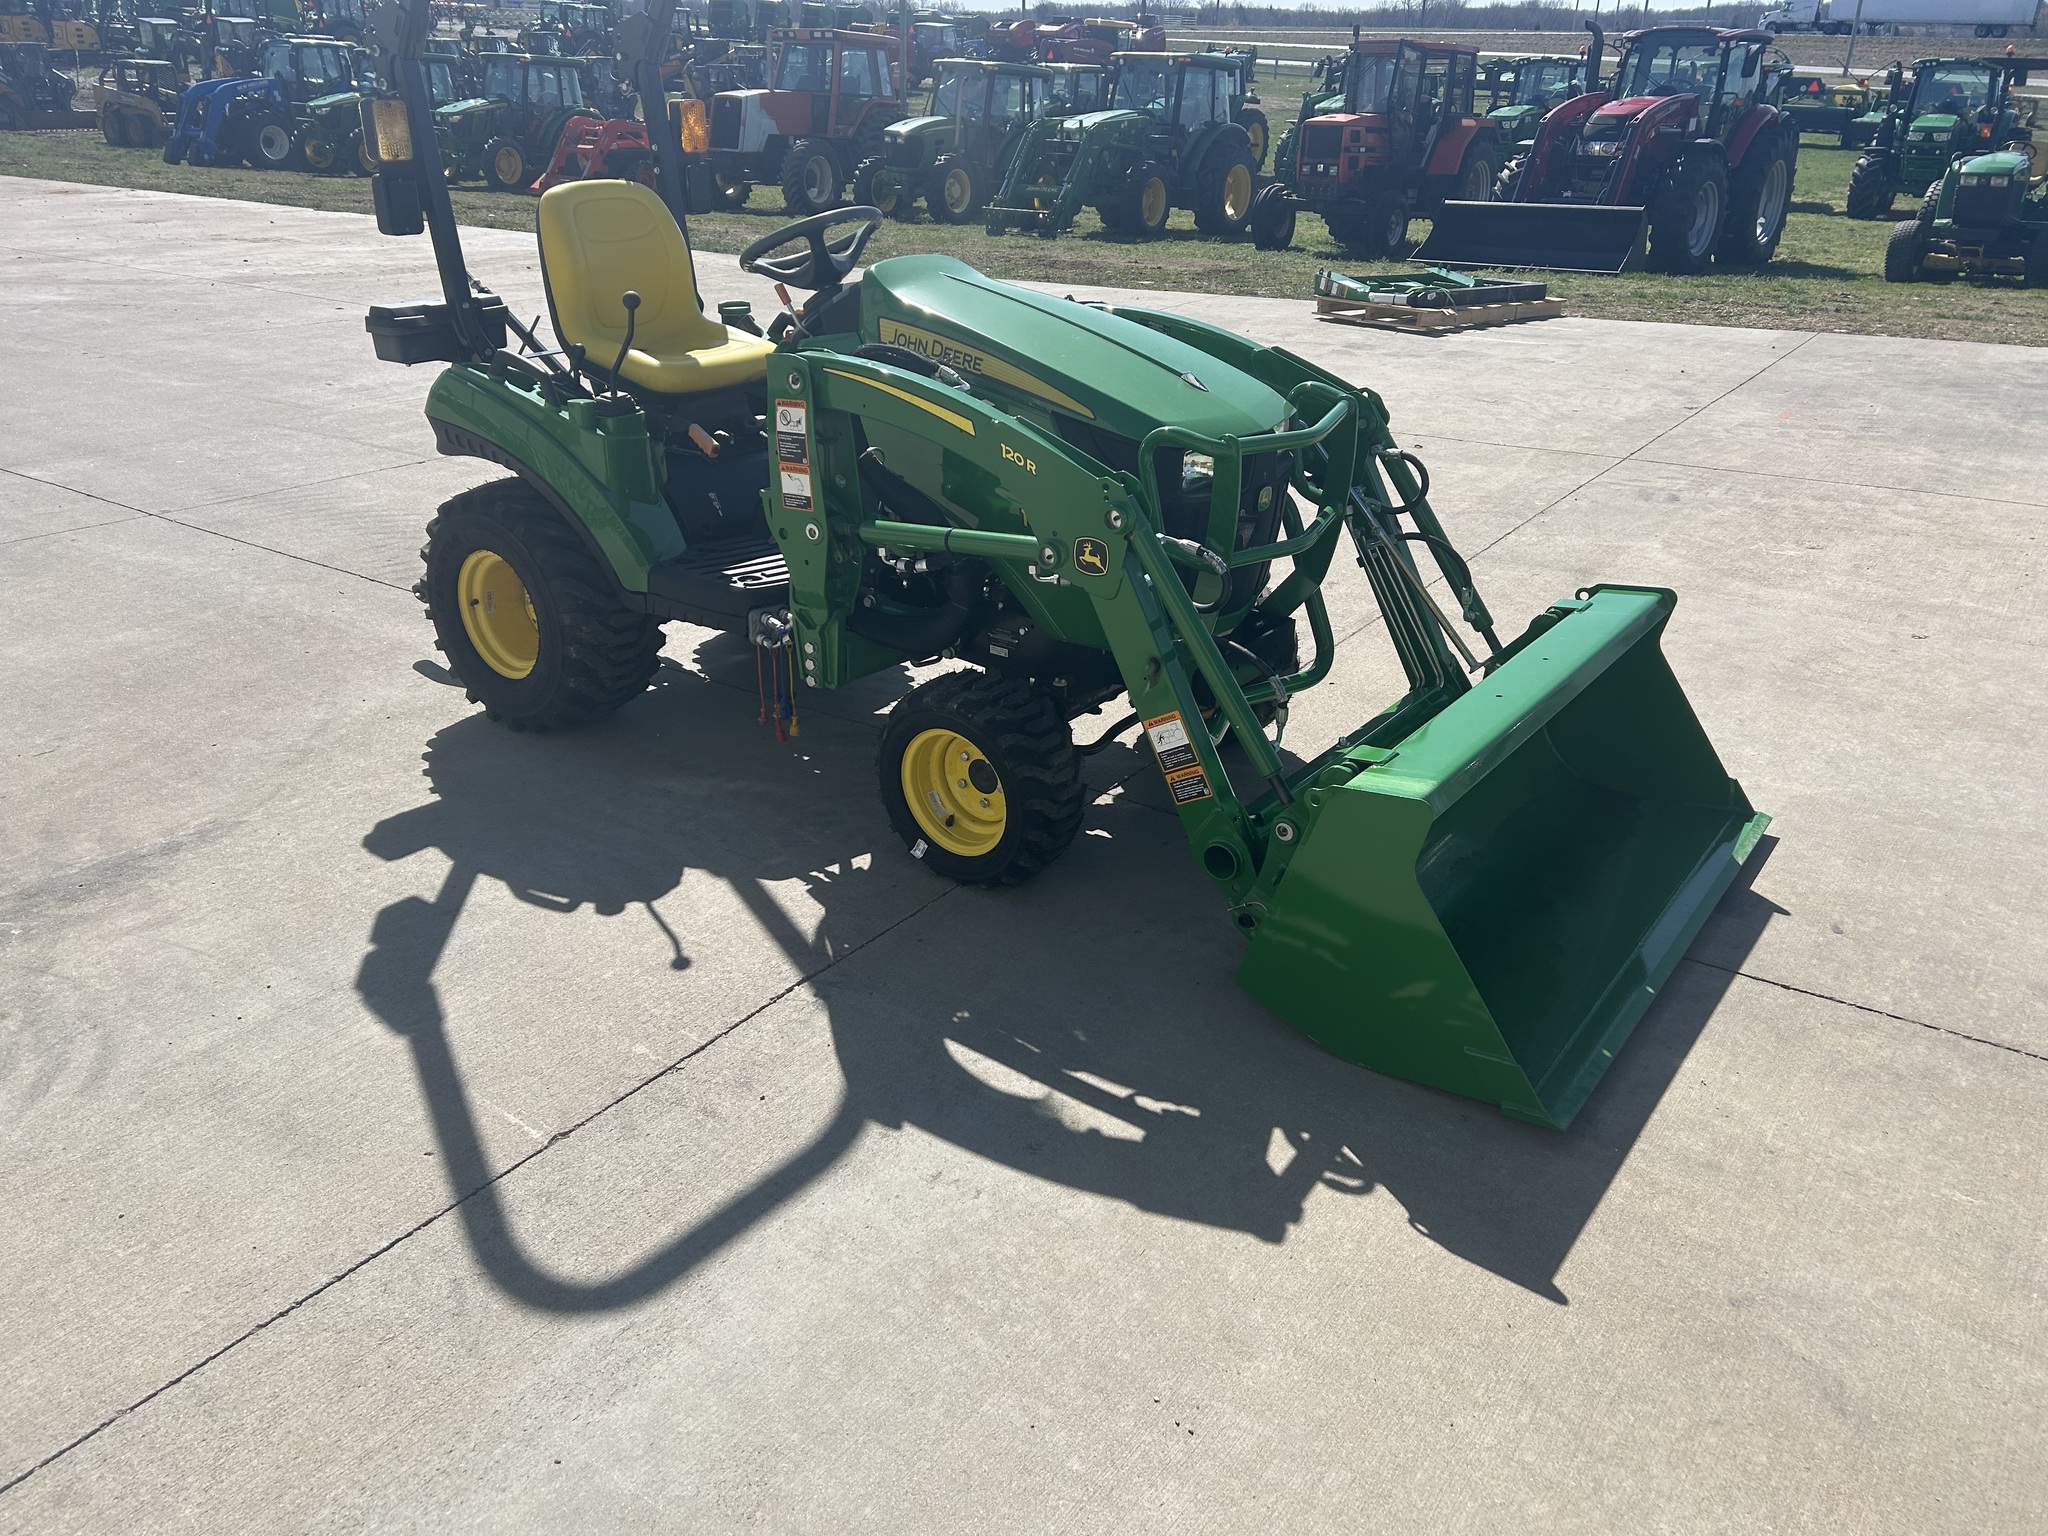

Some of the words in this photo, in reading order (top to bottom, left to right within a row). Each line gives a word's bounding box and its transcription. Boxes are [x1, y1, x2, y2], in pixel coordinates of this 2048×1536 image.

[888, 328, 929, 356] JOHN
[931, 339, 983, 372] DEERE
[781, 400, 805, 408] WARNING
[1154, 714, 1176, 724] WARNING
[1176, 769, 1200, 779] WARNING
